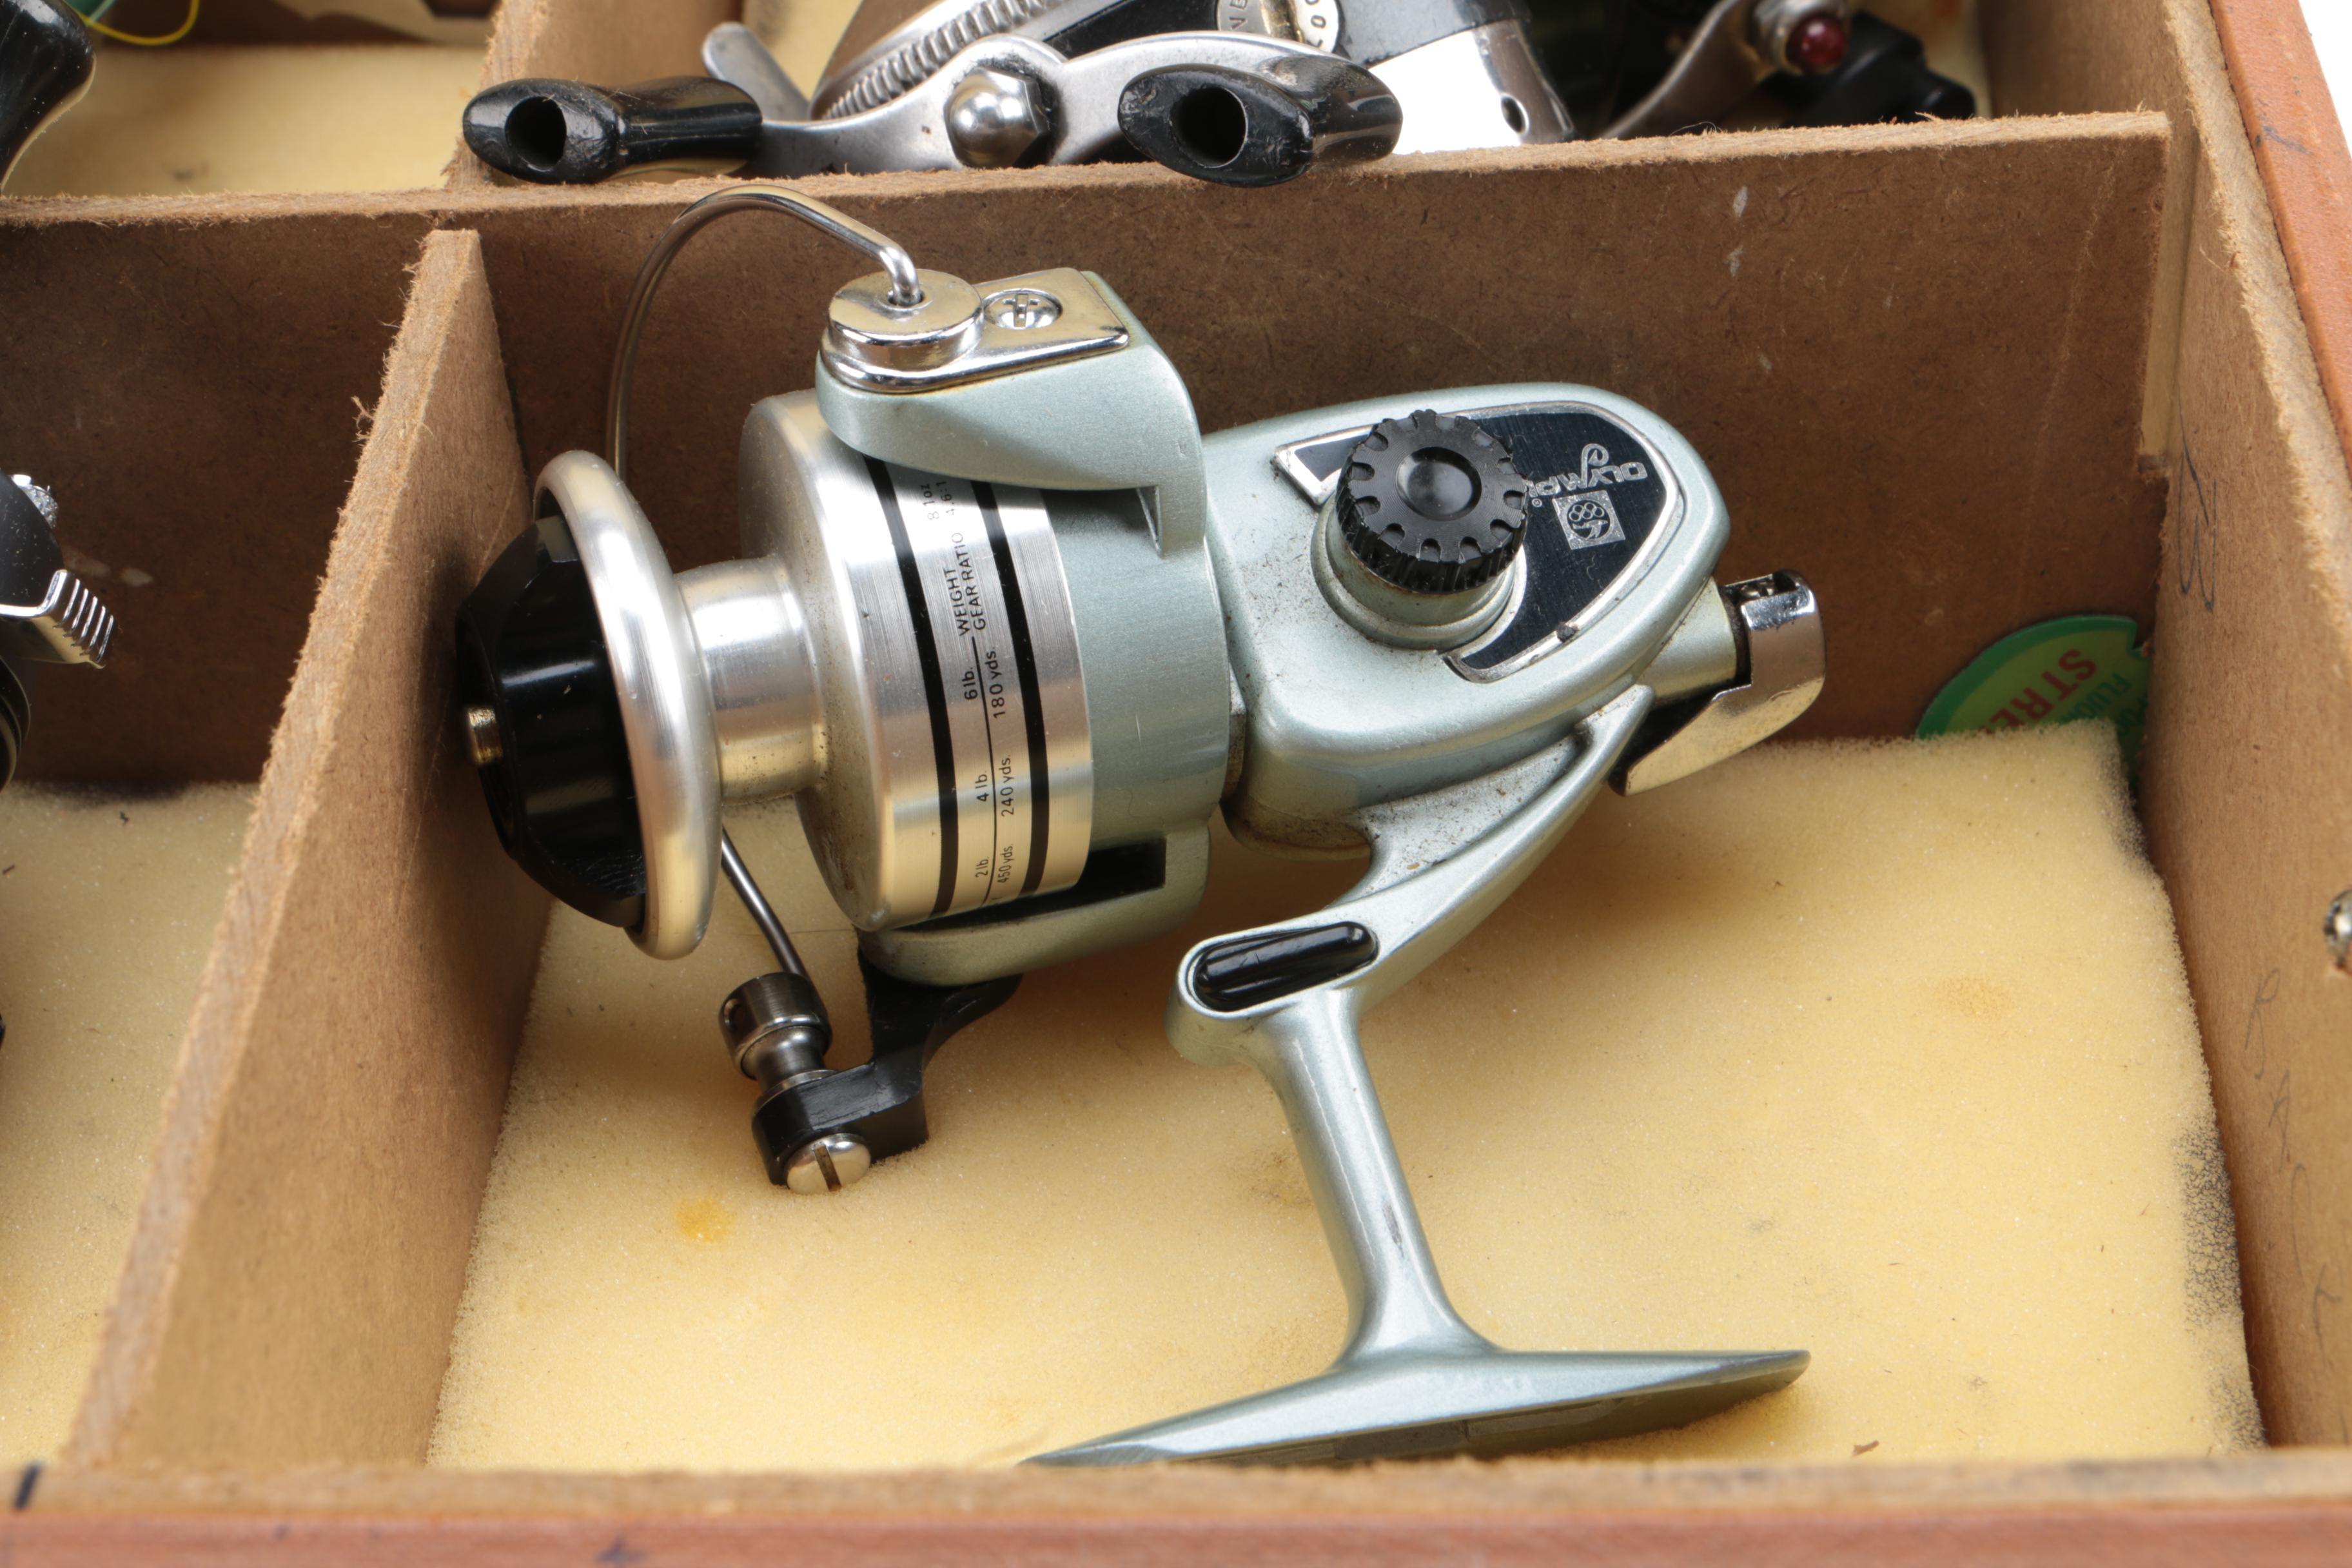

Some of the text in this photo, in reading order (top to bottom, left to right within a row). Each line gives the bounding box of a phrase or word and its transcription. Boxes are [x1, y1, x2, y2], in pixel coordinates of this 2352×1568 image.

[1524, 444, 1647, 498] OLYMPI
[951, 533, 975, 580] RATIO
[944, 567, 970, 636] WEIGHT
[965, 585, 986, 631] GEAR
[985, 647, 1003, 681] yds.
[990, 683, 1006, 718] 180
[1979, 649, 2097, 734] STRE
[999, 754, 1015, 783] yds.
[1001, 787, 1014, 816] 240
[997, 863, 1012, 883] 450
